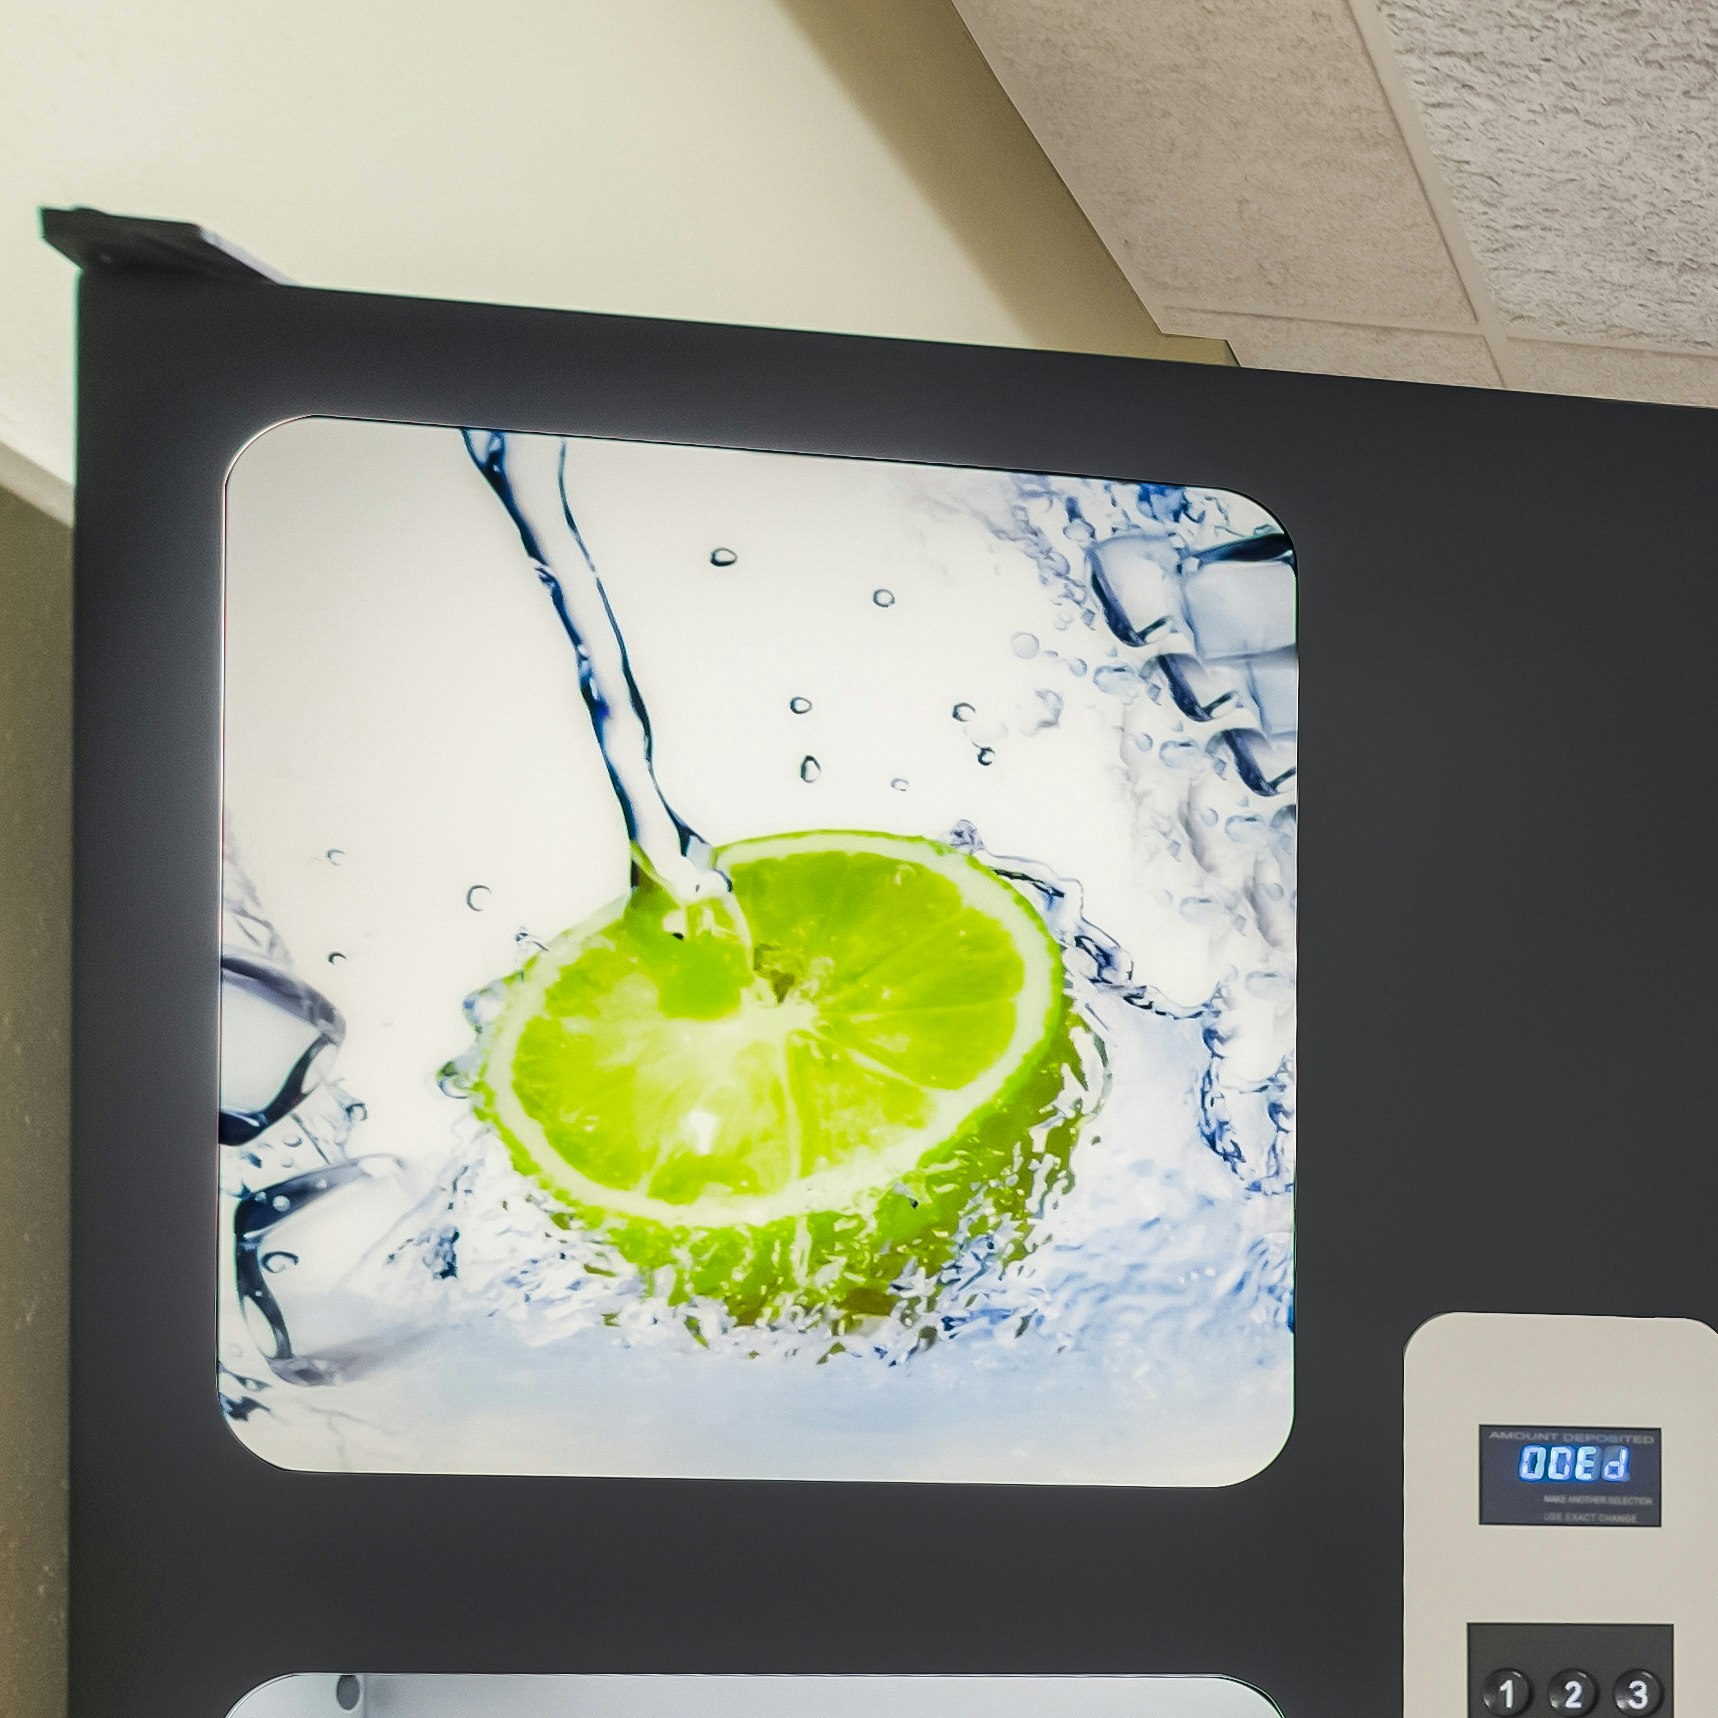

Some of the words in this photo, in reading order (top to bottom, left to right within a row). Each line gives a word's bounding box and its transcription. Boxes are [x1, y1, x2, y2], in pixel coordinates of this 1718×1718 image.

[1489, 1431, 1558, 1442] AMOUNT
[1563, 1432, 1655, 1445] DEPOSITED
[1544, 1512, 1562, 1522] USE
[1565, 1512, 1596, 1523] EXACT
[1600, 1513, 1637, 1524] CHANGE
[1499, 1679, 1514, 1708] 1
[1564, 1680, 1583, 1709] 2
[1629, 1680, 1648, 1710] 3
